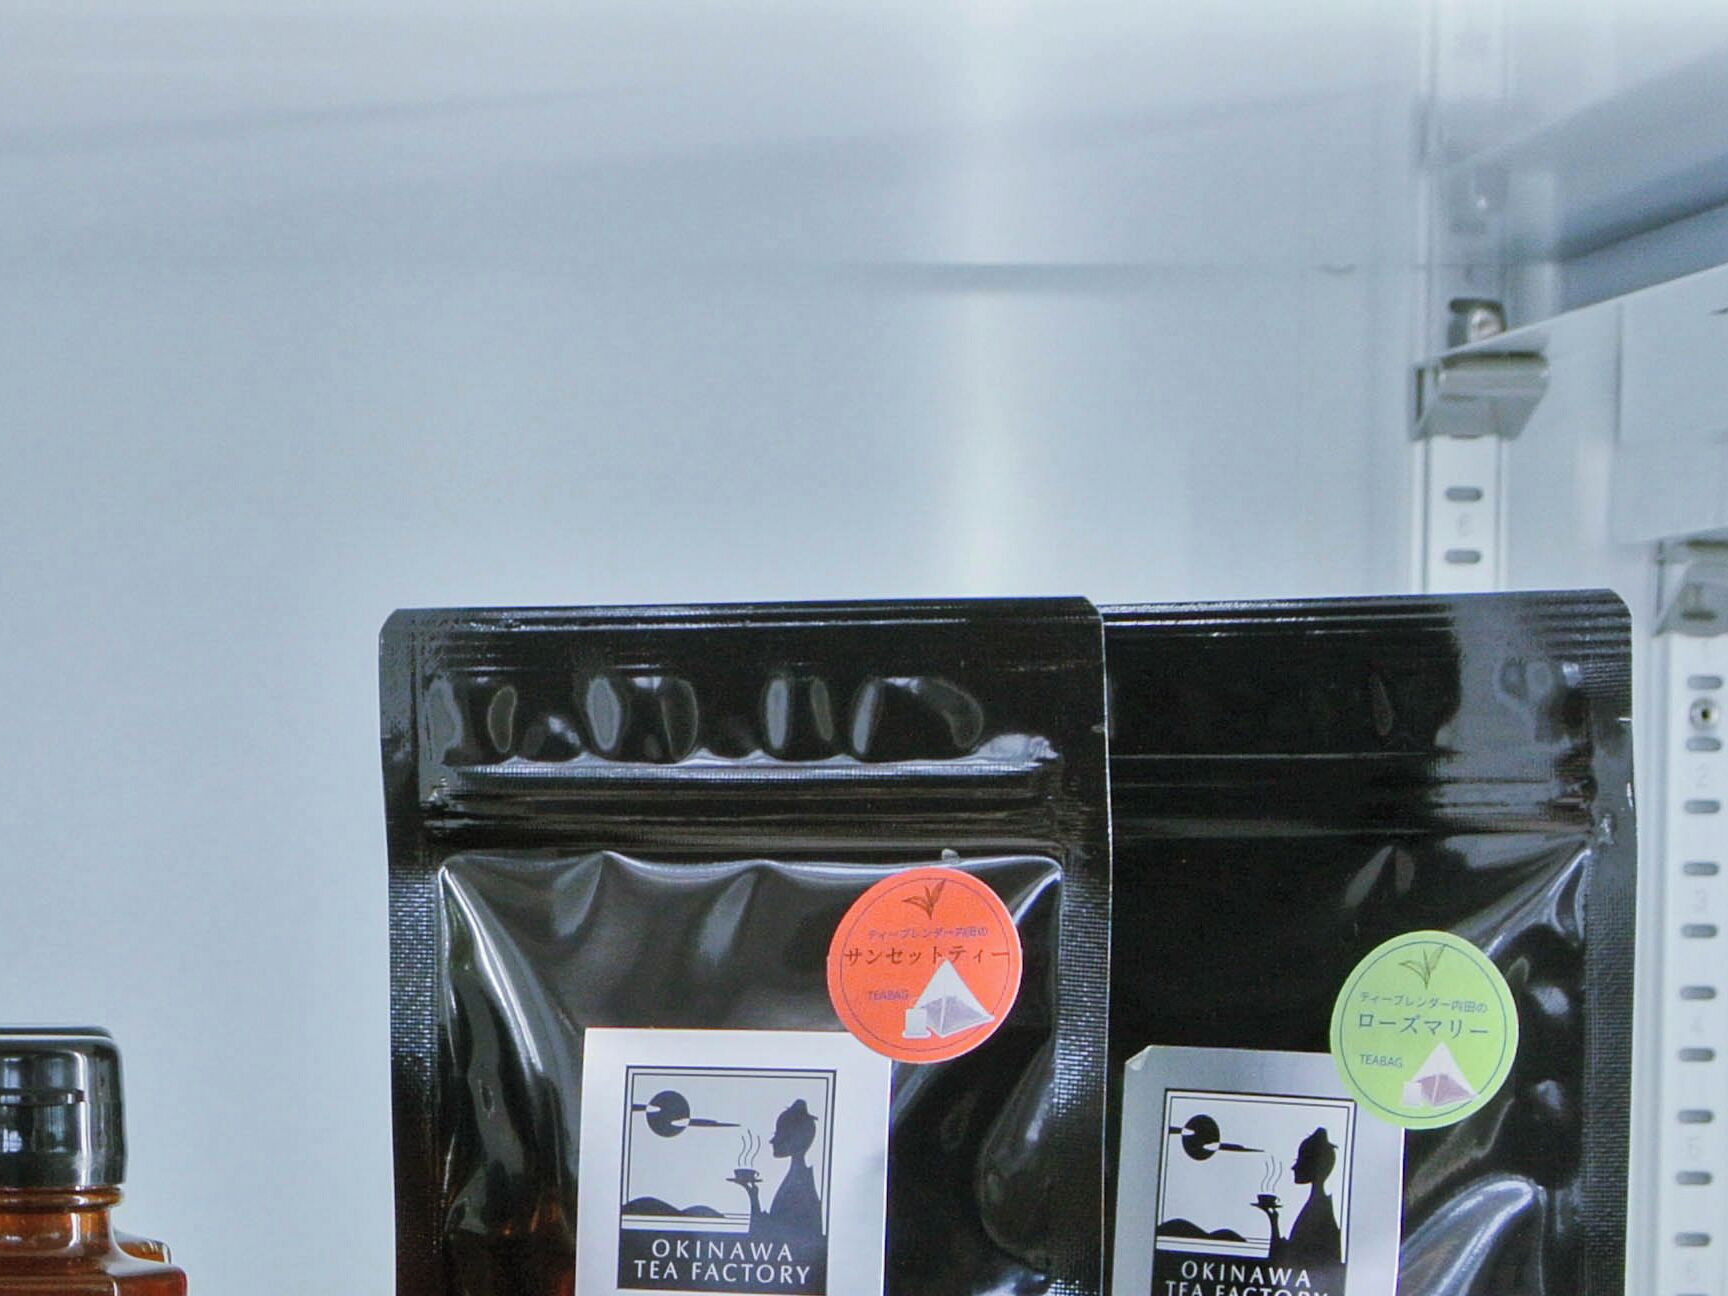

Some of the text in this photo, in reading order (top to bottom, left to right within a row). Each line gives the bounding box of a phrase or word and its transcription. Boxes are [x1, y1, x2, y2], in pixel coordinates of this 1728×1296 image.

[844, 945, 1010, 966] サンセットティー
[1359, 1013, 1489, 1039] ローズマリー
[1359, 1053, 1403, 1068] TEABAG
[652, 1239, 793, 1262] OKINAWA
[634, 1259, 810, 1285] TEA FACTORY
[1181, 1260, 1312, 1288] OKINAWA
